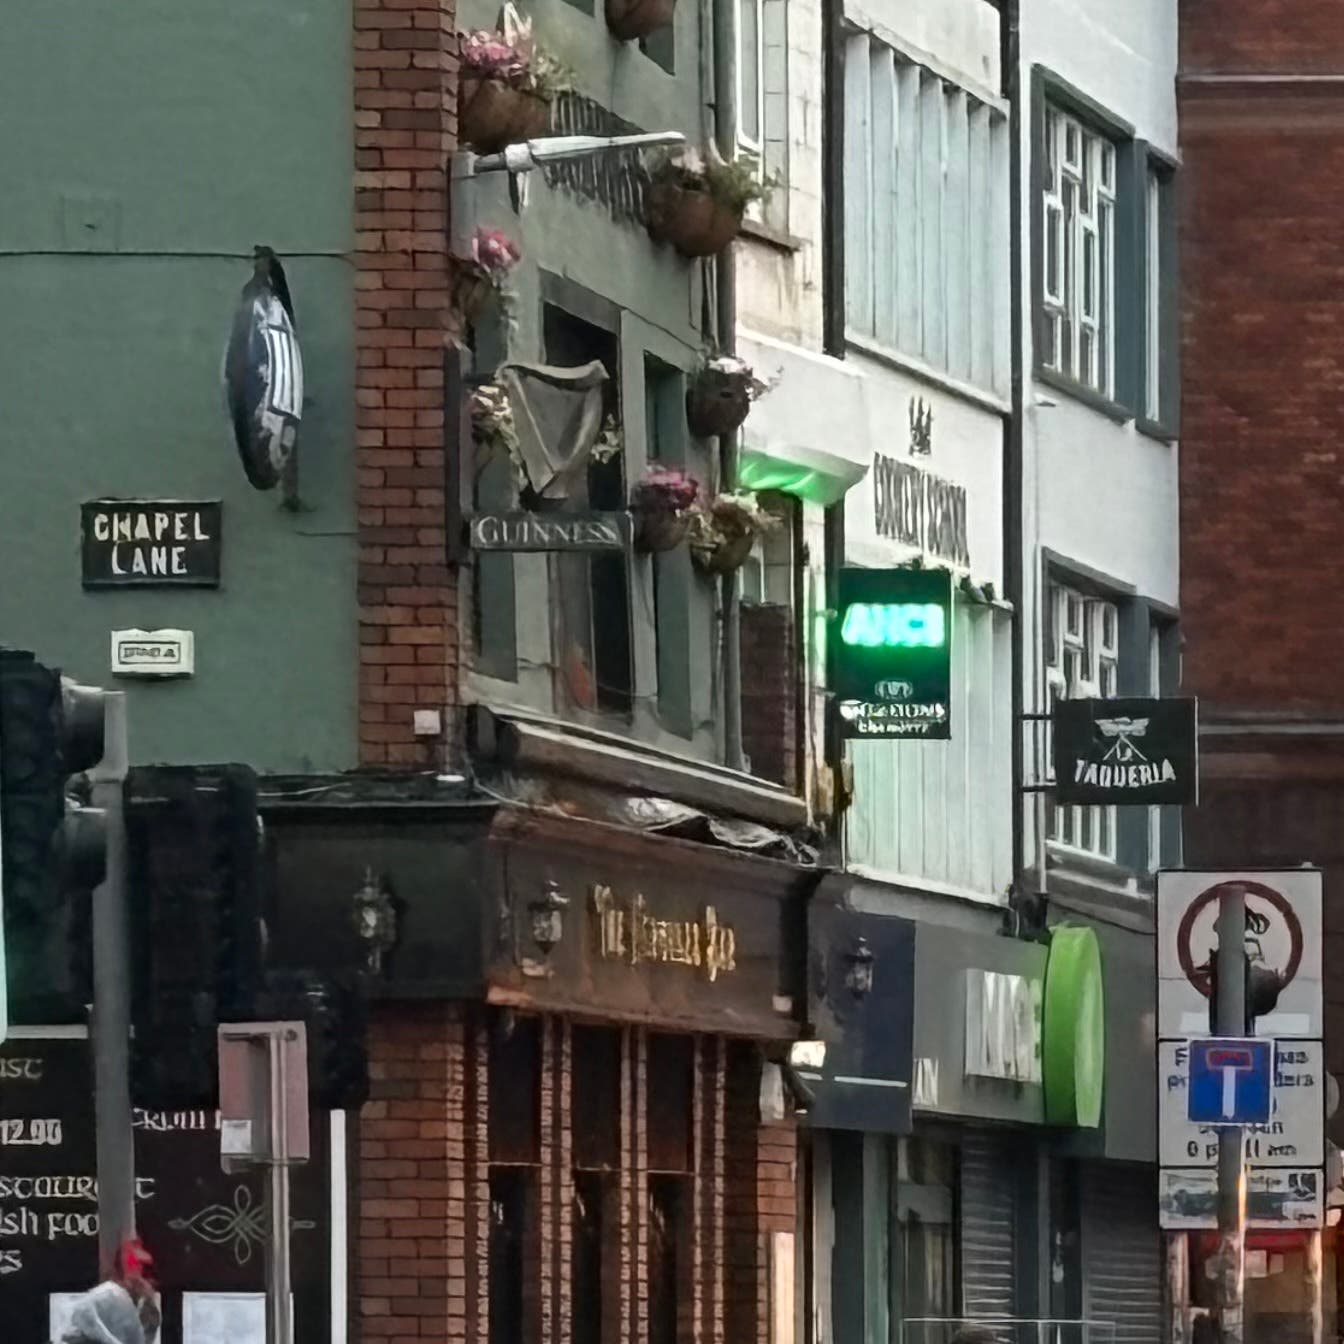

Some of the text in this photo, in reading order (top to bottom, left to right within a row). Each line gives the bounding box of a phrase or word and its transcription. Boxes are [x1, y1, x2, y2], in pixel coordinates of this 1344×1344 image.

[94, 512, 210, 542] CHAPEL
[476, 515, 625, 545] GUINNESS
[111, 544, 188, 576] LANE
[1074, 758, 1176, 788] TAQUERIA
